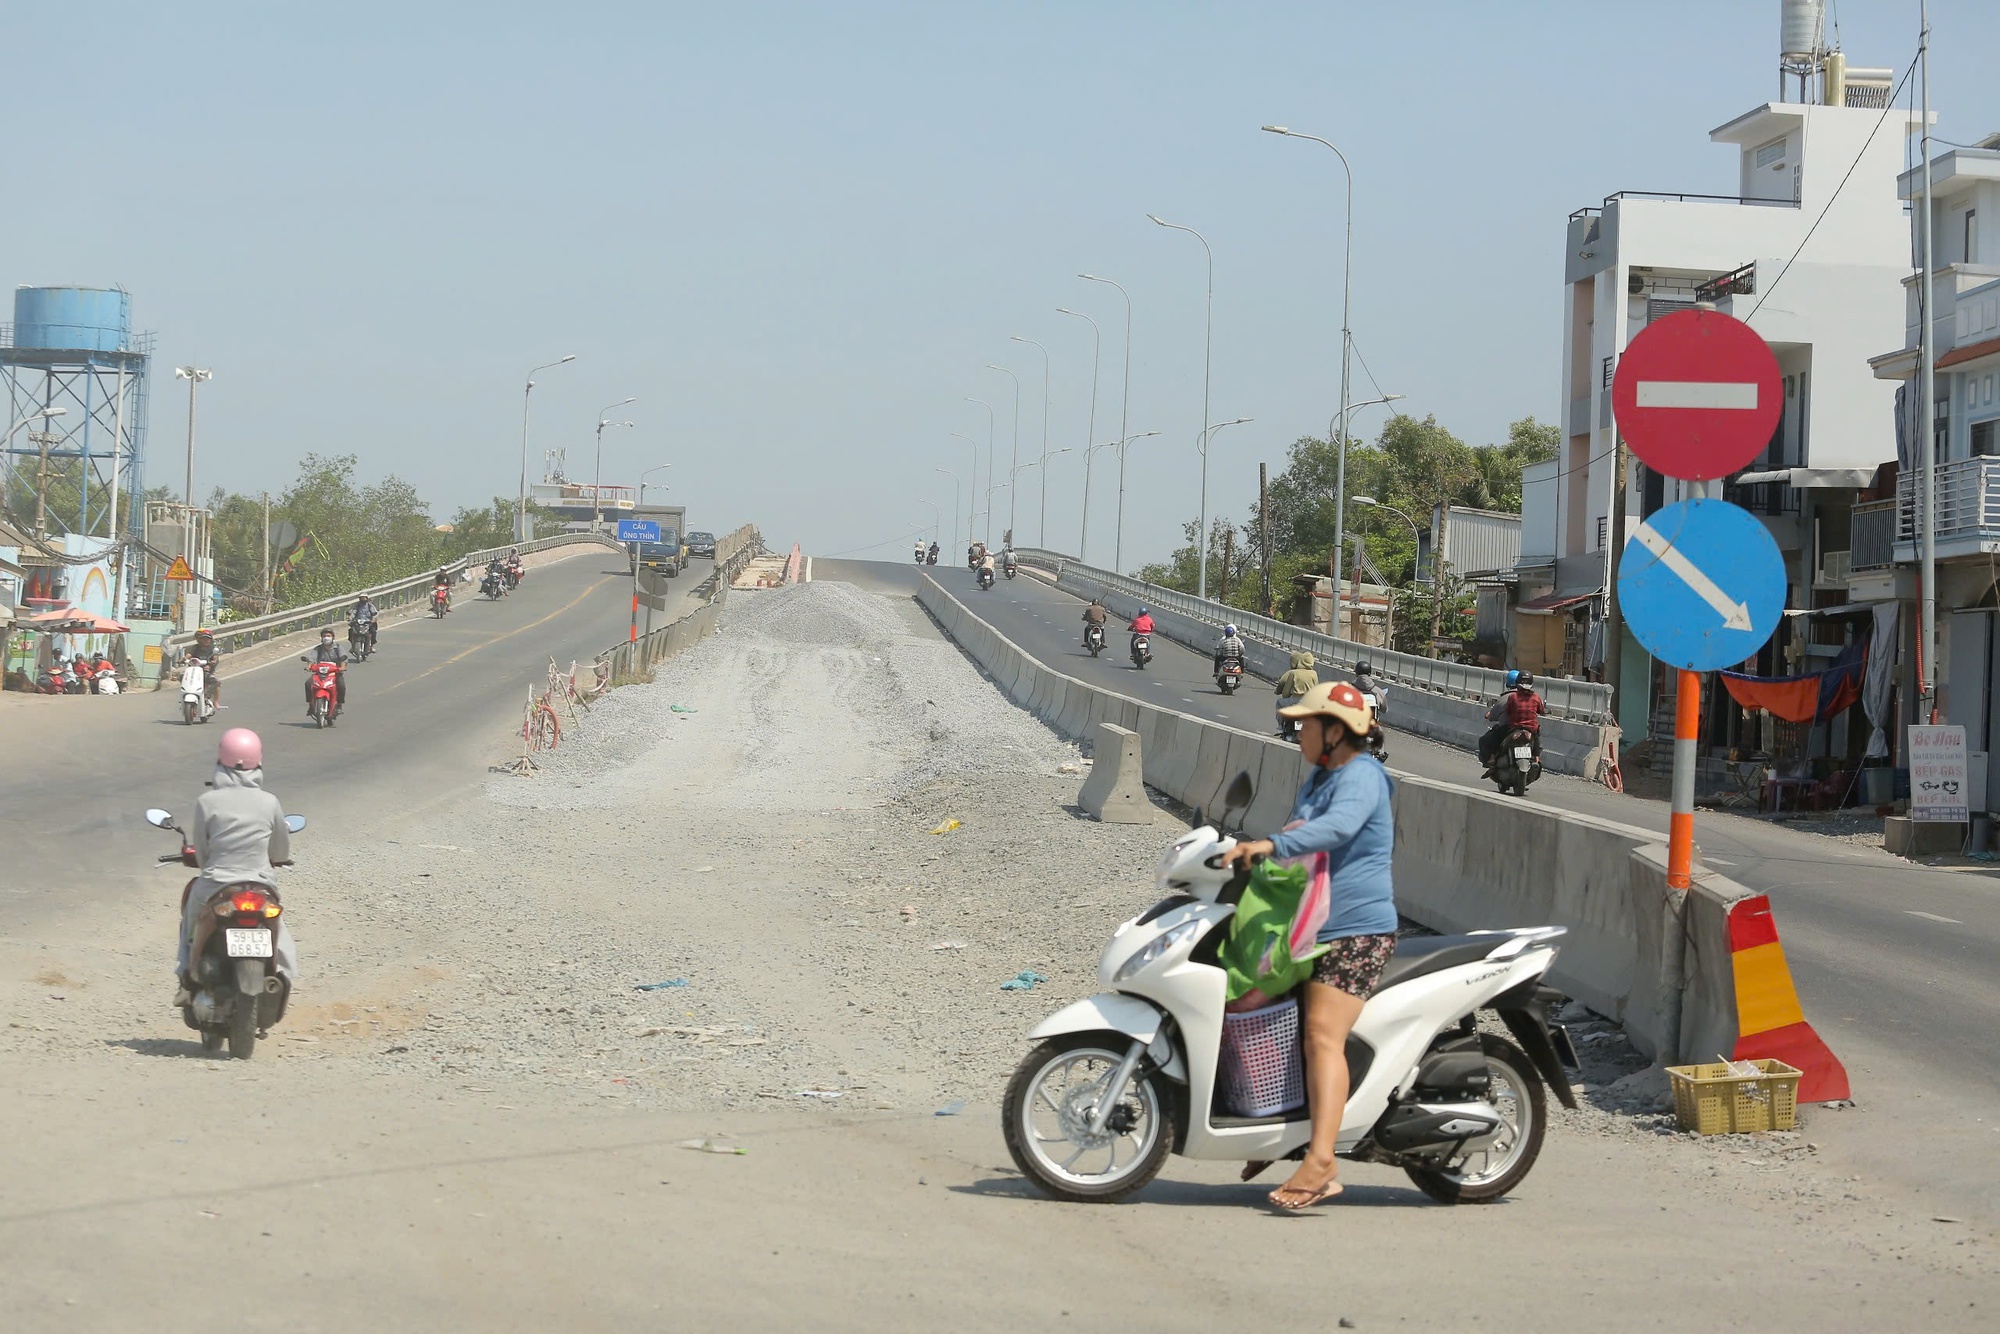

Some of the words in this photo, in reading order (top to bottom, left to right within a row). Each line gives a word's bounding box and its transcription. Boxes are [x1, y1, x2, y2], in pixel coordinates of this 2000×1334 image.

[632, 521, 647, 530] CẦU
[623, 531, 638, 539] ÔNG
[638, 532, 655, 540] THÌN
[1940, 765, 1963, 777] GAS
[1465, 965, 1513, 985] VISION
